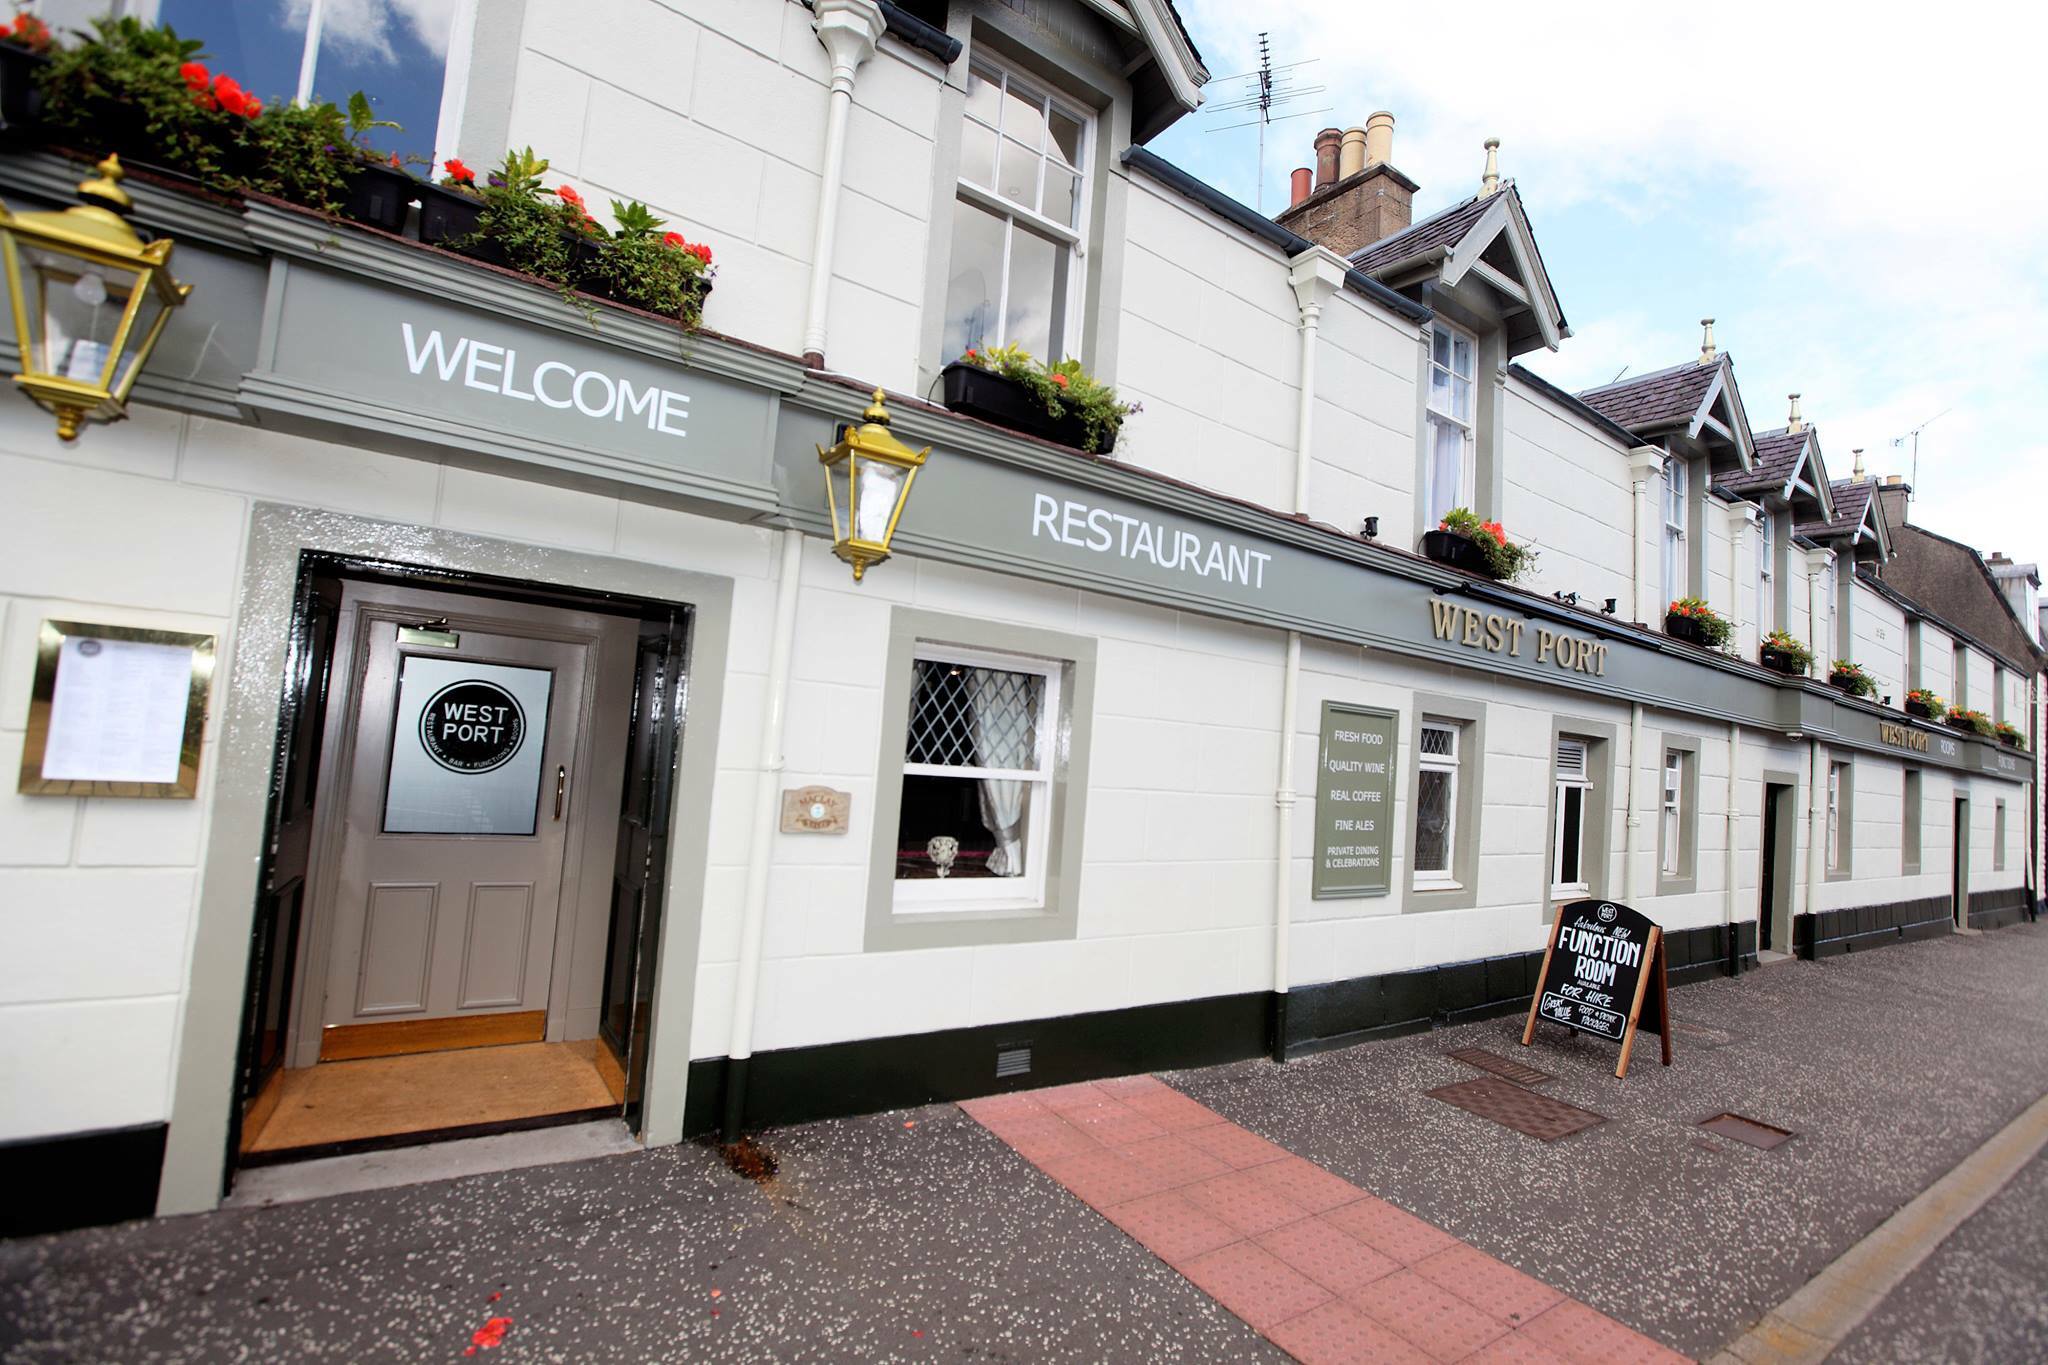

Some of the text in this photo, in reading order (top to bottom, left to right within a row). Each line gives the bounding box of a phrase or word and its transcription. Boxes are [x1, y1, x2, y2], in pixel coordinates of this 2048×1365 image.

[401, 322, 691, 437] WELCOME
[1032, 493, 1271, 589] RESTAURANT
[1430, 597, 1609, 677] WEST PORT
[444, 702, 509, 724] WEST
[426, 712, 519, 768] RESTAURANT BAR FUNCTIONS ROOMS
[442, 723, 504, 744] PORT
[1334, 730, 1384, 745] FRESH FOOD
[1880, 721, 1904, 748] WEST
[1907, 728, 1930, 753] PORT
[1328, 759, 1385, 774] QUALITY WINE
[1330, 790, 1381, 802] REAL COFFEE
[1335, 819, 1375, 831] FINE ALES
[1327, 846, 1379, 856] PRIVATE DINING
[1325, 857, 1380, 868] & CELEBRATIONS
[1601, 906, 1615, 914] WEST
[1601, 912, 1614, 920] PORT
[1612, 926, 1631, 938] NEW
[1558, 926, 1642, 968] FUNCTION
[1574, 955, 1617, 987] ROOM
[1577, 979, 1601, 990] AVAILABLE
[1560, 983, 1614, 1008] FOR HIRE
[1578, 1005, 1594, 1016] FOOD
[1599, 1011, 1618, 1024] DRINK
